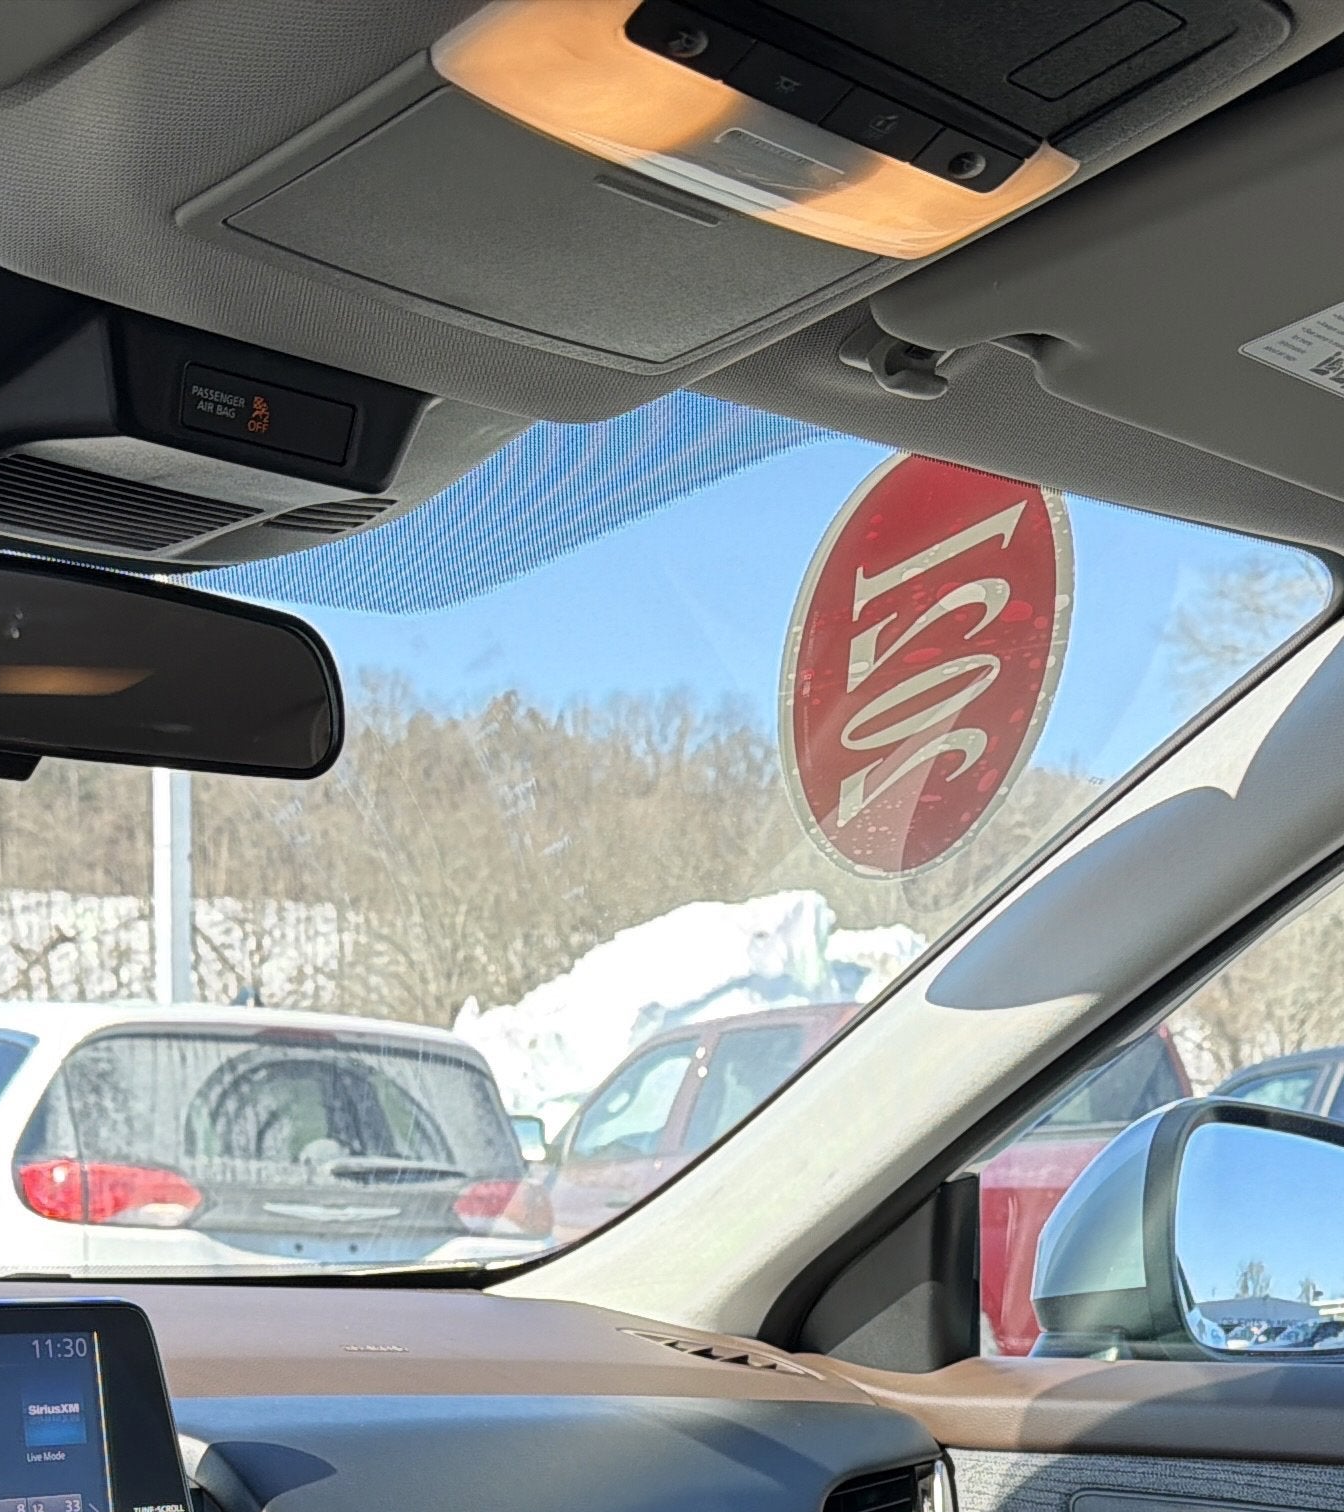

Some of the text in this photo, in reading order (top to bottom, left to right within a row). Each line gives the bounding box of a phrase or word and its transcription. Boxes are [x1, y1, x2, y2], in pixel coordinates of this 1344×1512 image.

[191, 385, 246, 409] PASSENGER
[197, 400, 236, 419] AIR BAG
[247, 420, 269, 433] OFF
[31, 1337, 87, 1359] 11:30
[28, 1402, 80, 1416] SiriusXM
[26, 1451, 67, 1463] Live Mode
[65, 1499, 81, 1512] 33
